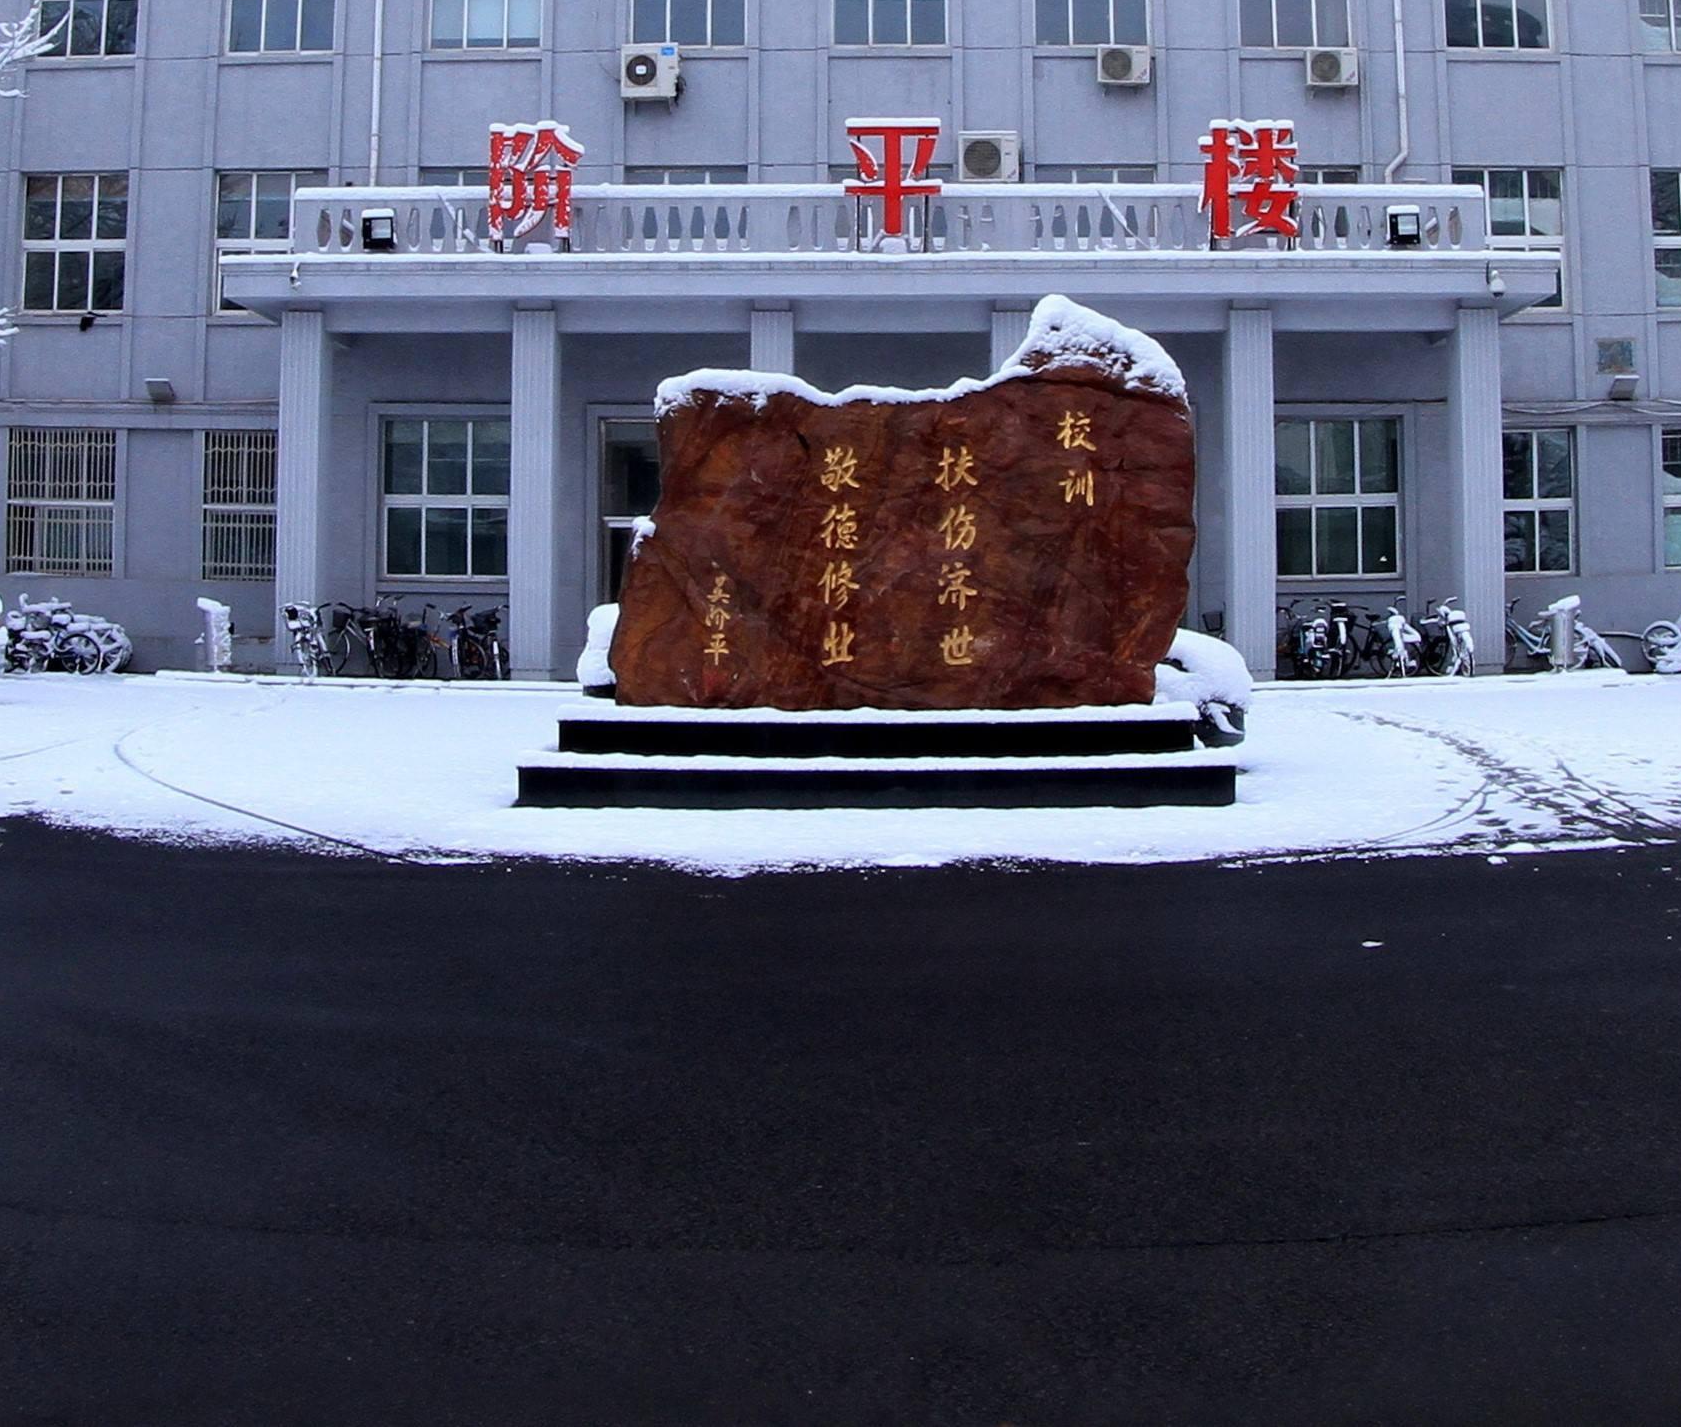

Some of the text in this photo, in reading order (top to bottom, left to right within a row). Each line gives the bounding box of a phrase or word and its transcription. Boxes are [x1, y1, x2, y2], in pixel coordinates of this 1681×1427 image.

[488, 123, 1300, 239] 阶平楼
[1056, 410, 1097, 507] 校训
[818, 446, 860, 666] 敬德修业
[934, 446, 979, 666] 扶伤济世
